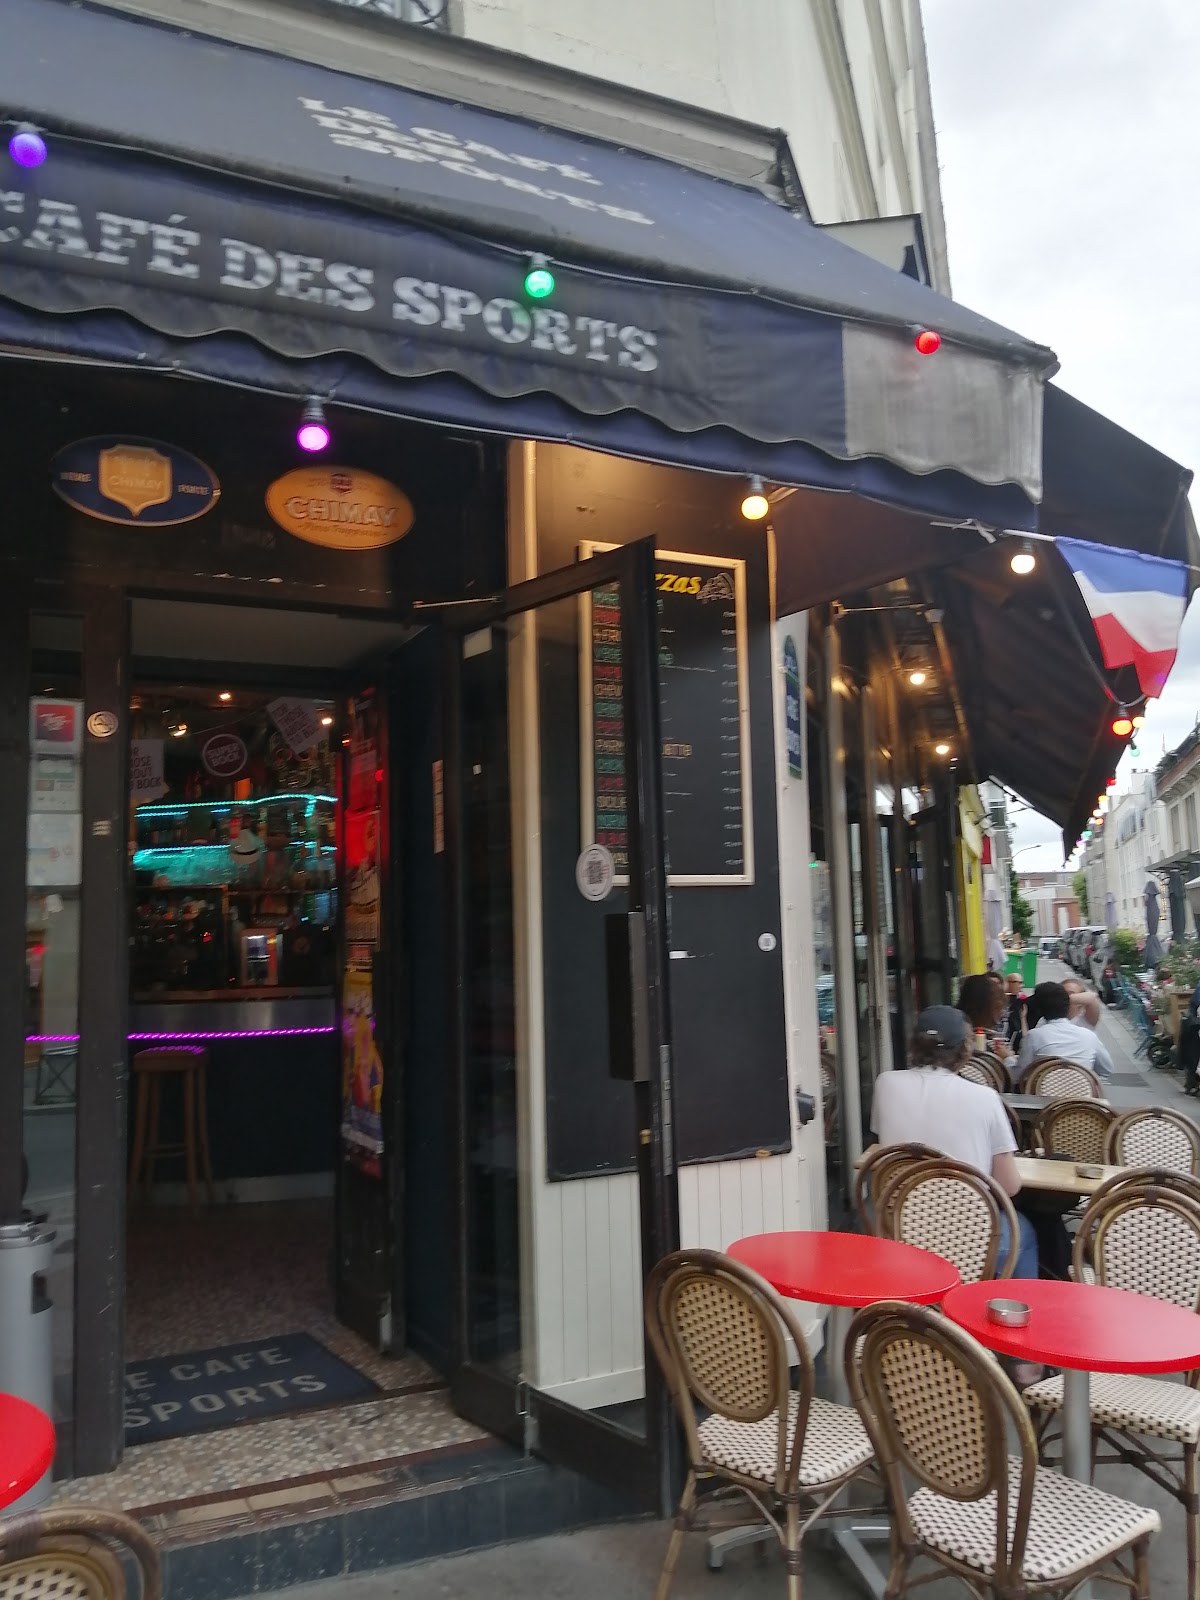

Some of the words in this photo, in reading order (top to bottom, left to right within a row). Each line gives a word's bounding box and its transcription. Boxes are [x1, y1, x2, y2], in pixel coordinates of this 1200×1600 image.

[296, 96, 398, 129] LE
[328, 132, 656, 226] SPORTS
[219, 237, 376, 313] DES
[391, 276, 660, 373] SPORTS
[284, 495, 399, 528] CHIMAY
[207, 743, 240, 759] SUPER
[211, 751, 241, 767] BOCK
[130, 767, 152, 779] OUT
[137, 777, 161, 790] BOCK
[124, 1370, 158, 1391] E
[169, 1347, 292, 1381] CAFE
[123, 1374, 327, 1429] SPORTS
